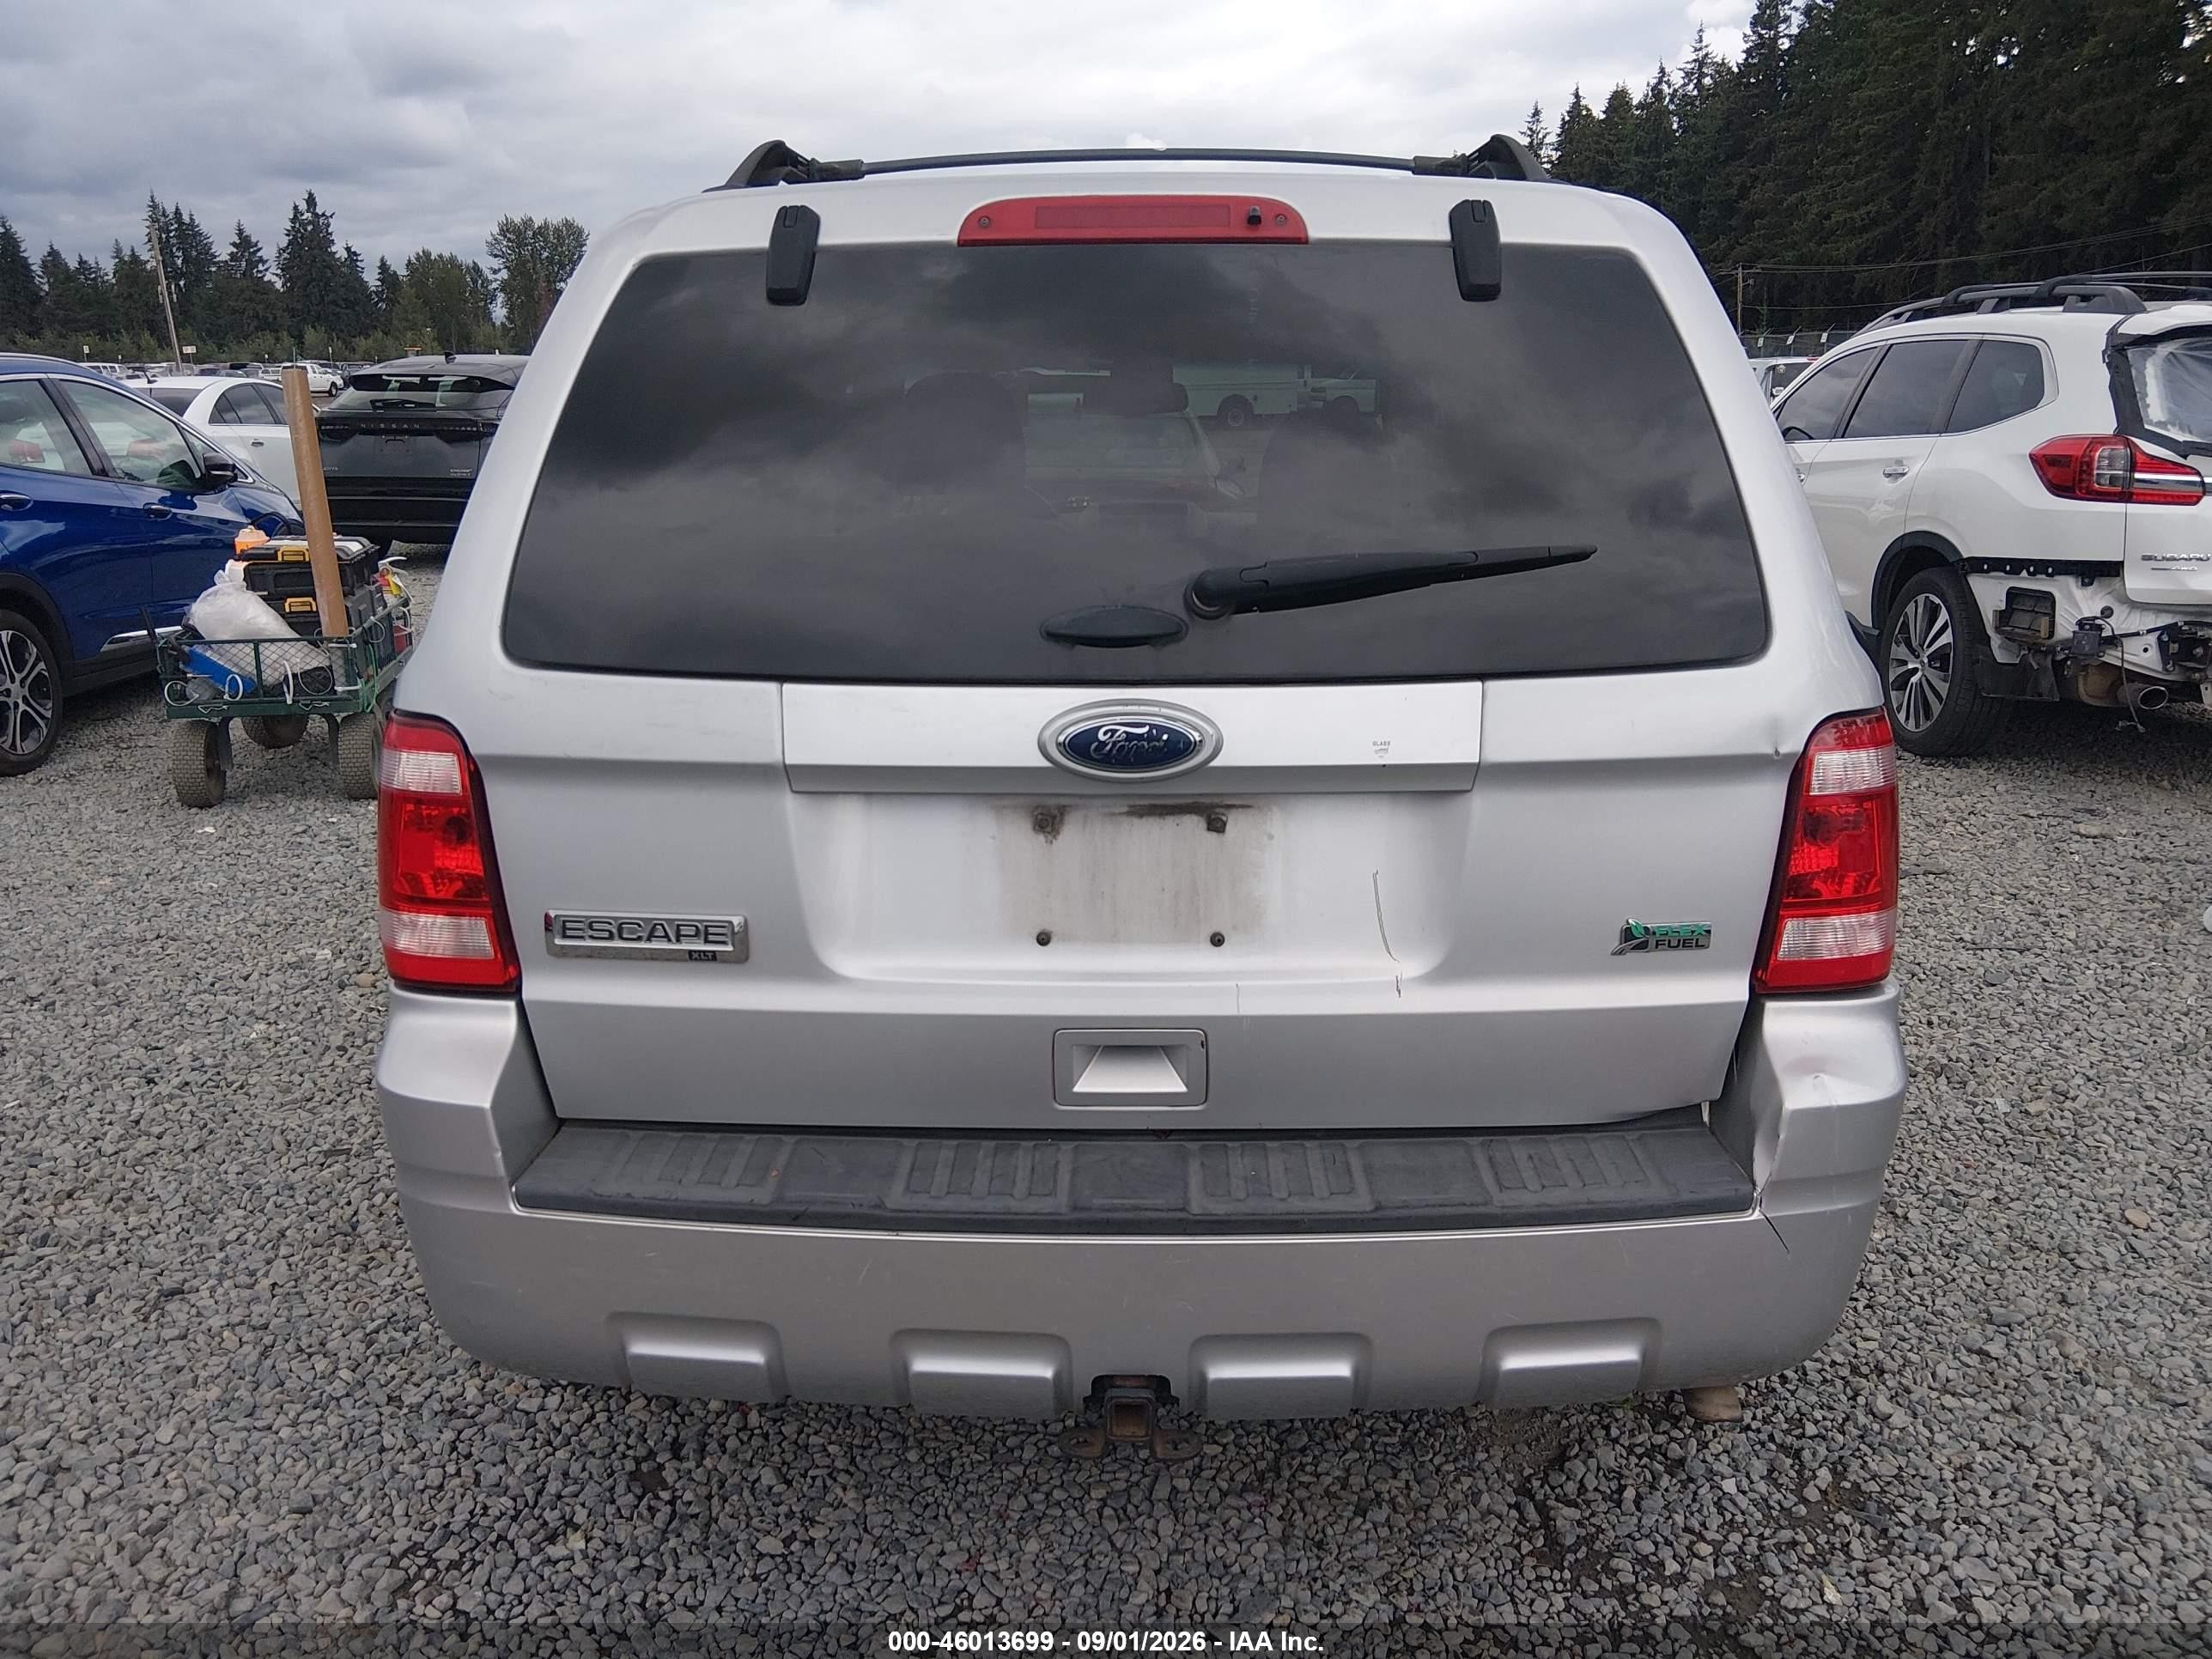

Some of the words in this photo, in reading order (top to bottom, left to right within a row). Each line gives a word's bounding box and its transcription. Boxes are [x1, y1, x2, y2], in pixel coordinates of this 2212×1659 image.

[1089, 725, 1171, 760] Ford
[560, 918, 731, 945] ESCAPE
[1653, 924, 1711, 937] FLEX
[1655, 938, 1705, 949] FUEL
[691, 951, 714, 960] XLT
